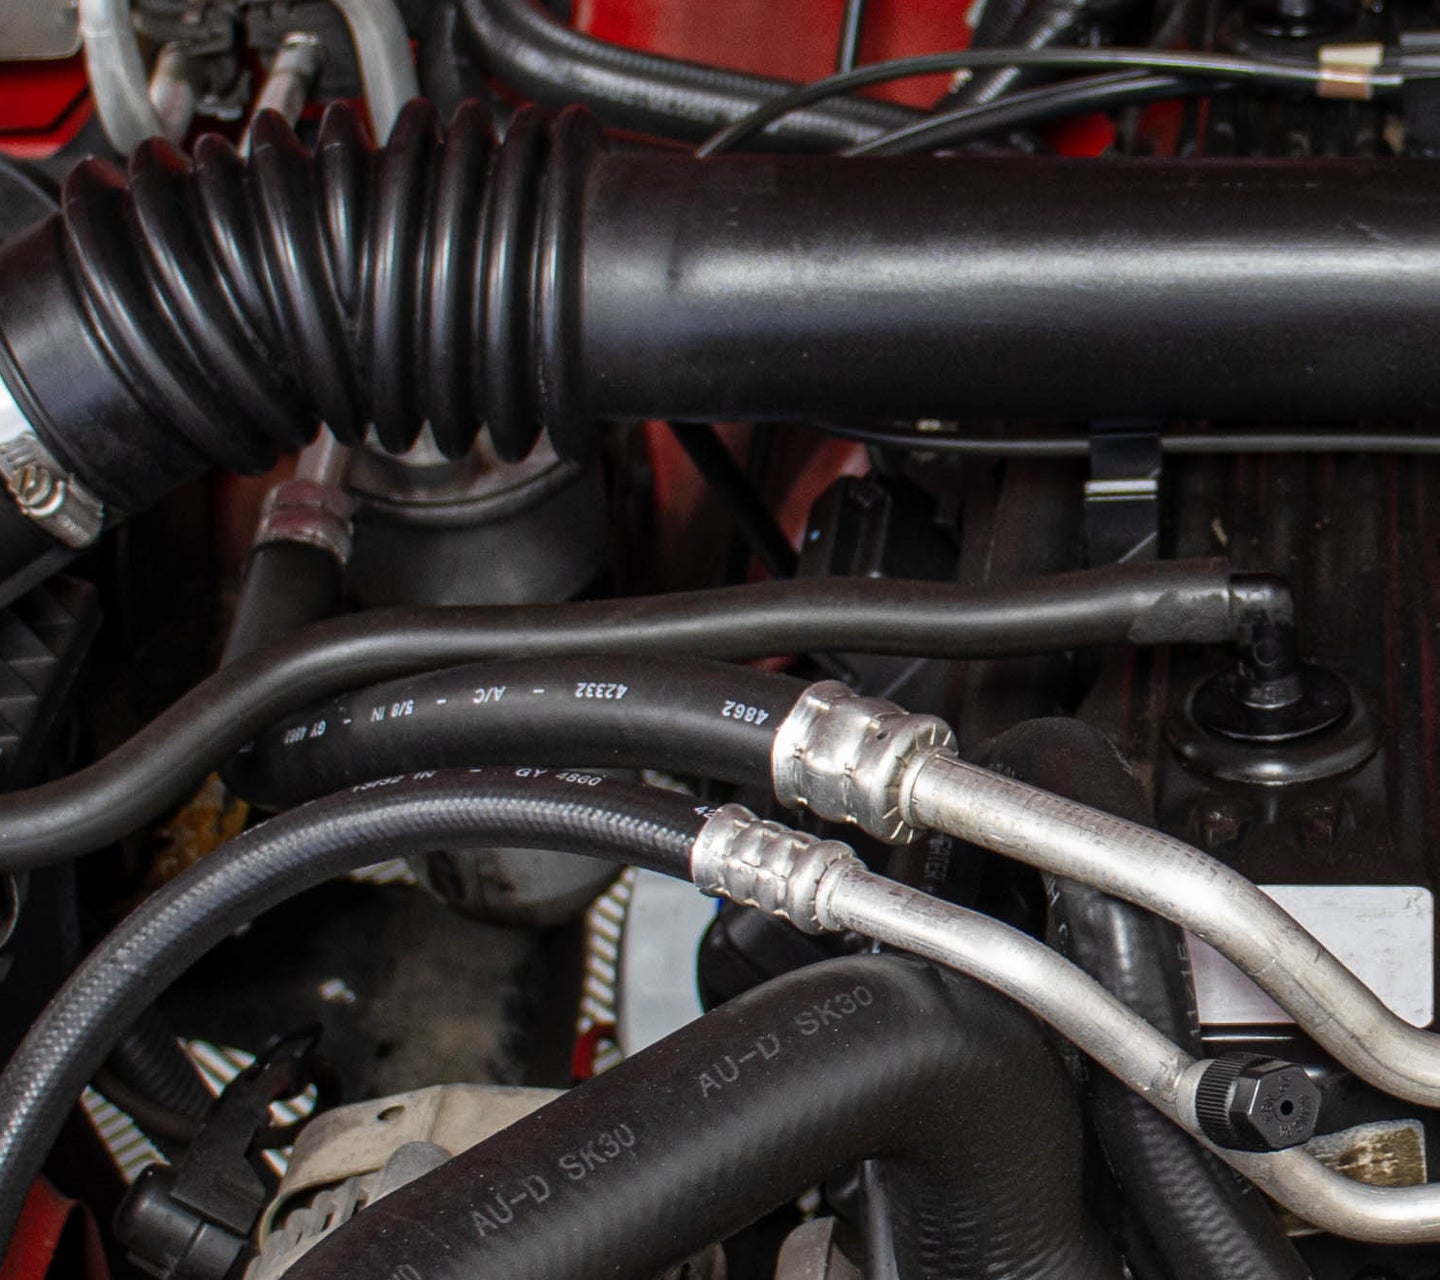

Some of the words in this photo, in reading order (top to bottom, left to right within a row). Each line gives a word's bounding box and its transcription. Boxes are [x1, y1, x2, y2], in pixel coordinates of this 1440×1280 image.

[472, 686, 507, 704] A/C
[575, 681, 629, 700] 42332
[370, 704, 386, 722] IN
[390, 699, 414, 718] 5/8
[721, 700, 769, 726] 4862
[514, 767, 548, 779] GY
[696, 1034, 782, 1098] AU-D
[793, 985, 875, 1037] SK30
[468, 1173, 552, 1237] AU-D
[558, 1123, 637, 1182] SK30
